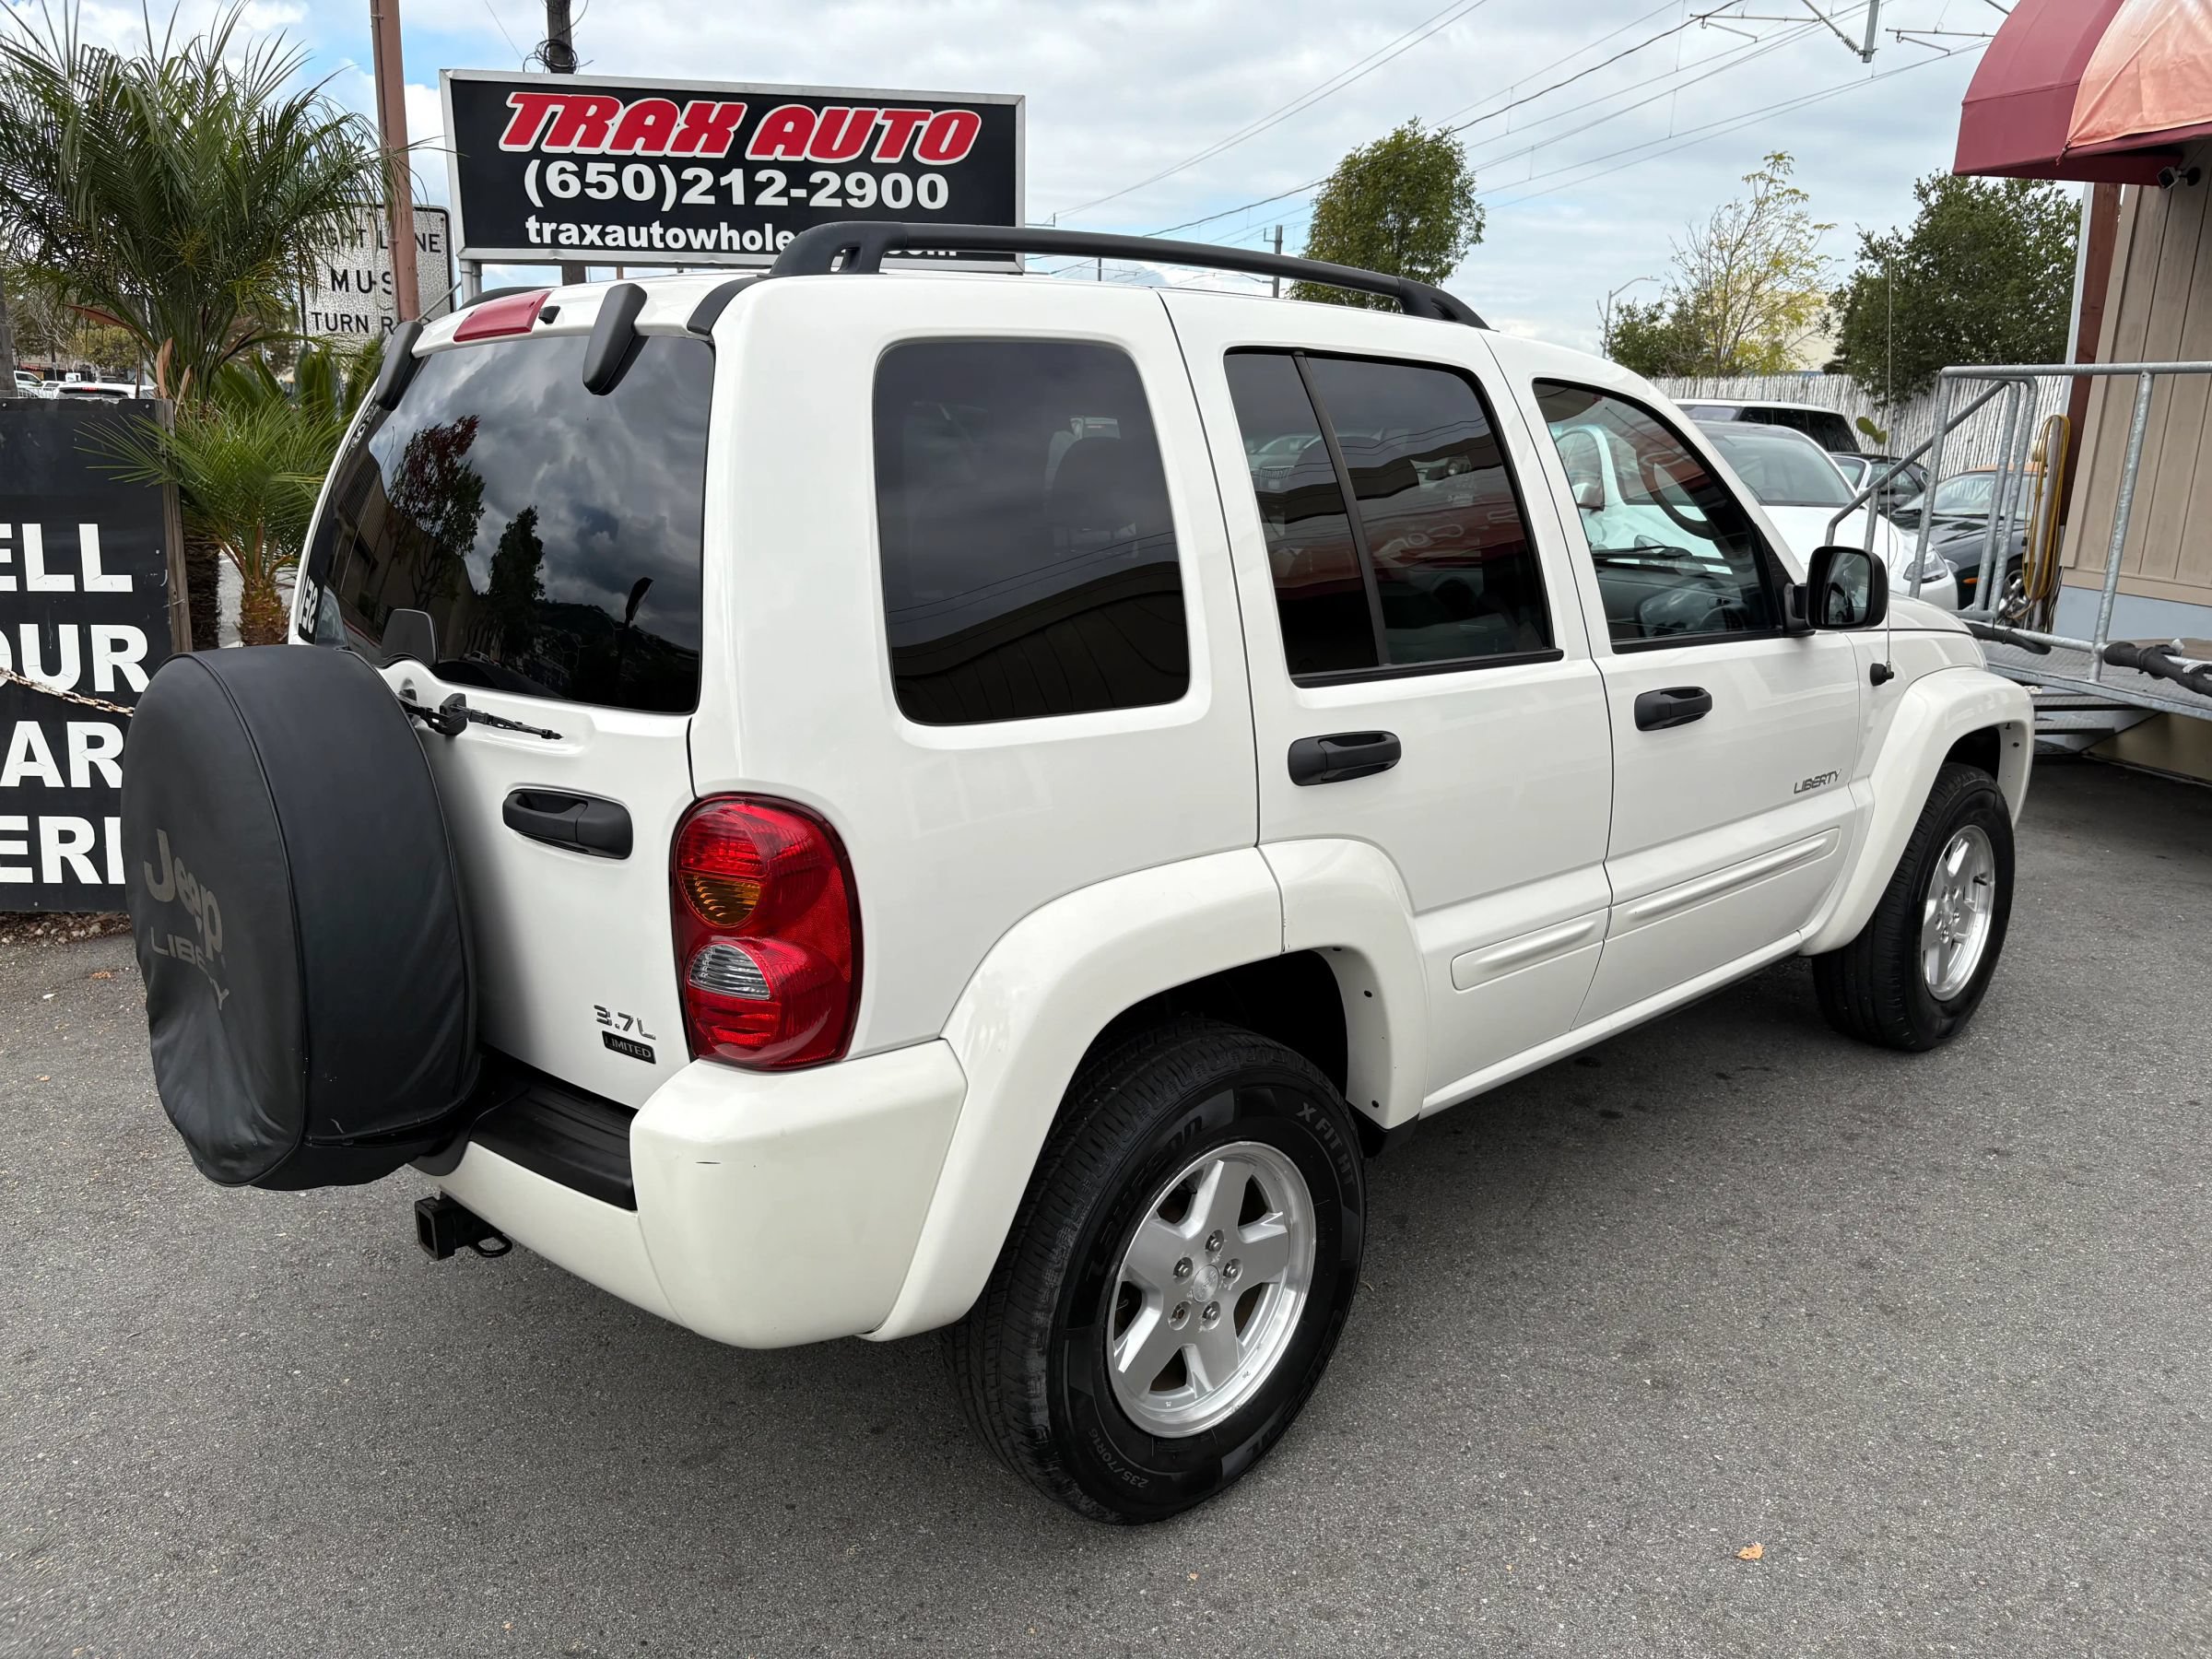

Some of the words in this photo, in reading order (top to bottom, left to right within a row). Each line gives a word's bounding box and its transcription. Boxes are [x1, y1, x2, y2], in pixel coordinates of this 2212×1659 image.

[499, 91, 747, 159] TRAX
[746, 103, 982, 165] AUTO
[524, 159, 949, 212] (650)212-2900
[379, 229, 441, 253] LNE
[330, 268, 393, 295] MUS
[311, 312, 370, 334] TURN
[0, 623, 150, 693] UR
[1793, 769, 1842, 794] LIBERTY
[593, 1004, 657, 1041] 3.7L
[604, 1034, 653, 1059] LIMITED
[1296, 1101, 1317, 1122] X
[1314, 1112, 1343, 1149] FIT
[1088, 1428, 1149, 1488] 235/70R16
